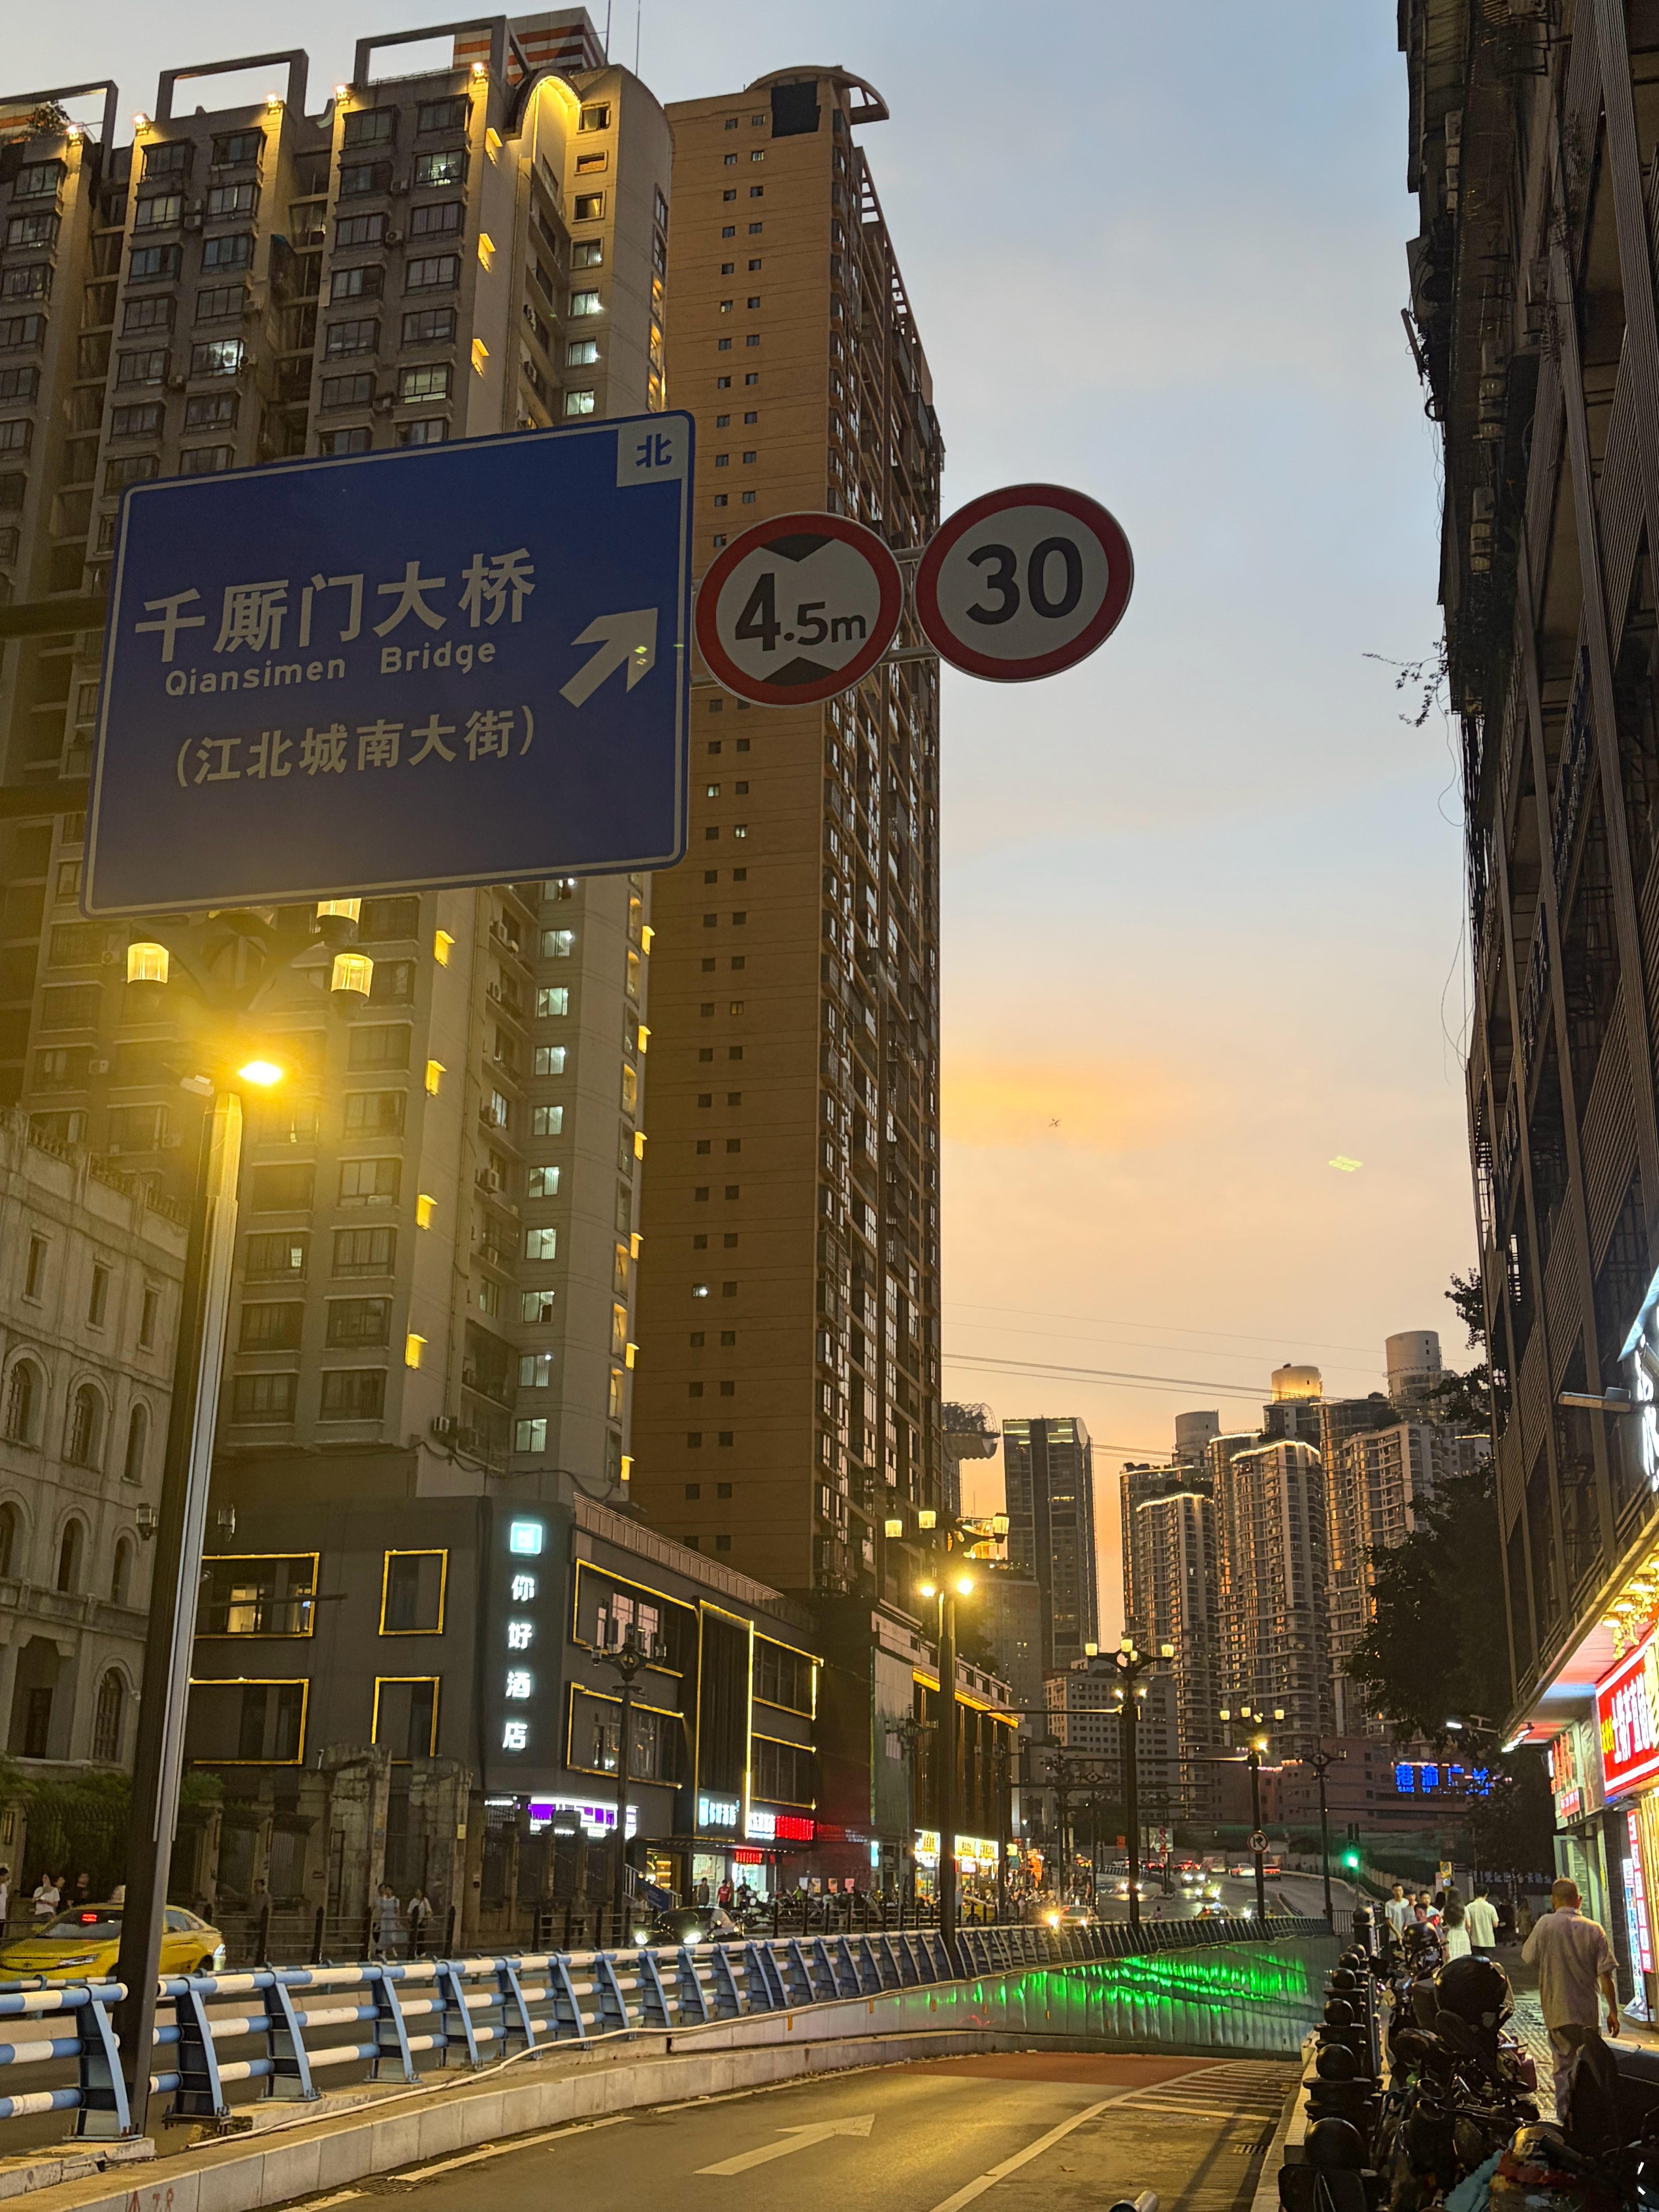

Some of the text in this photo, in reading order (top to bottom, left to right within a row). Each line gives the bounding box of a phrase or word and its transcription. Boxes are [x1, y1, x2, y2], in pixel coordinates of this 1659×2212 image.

[636, 434, 672, 468] 北
[135, 548, 535, 663] 千厮门大桥
[735, 572, 867, 652] 4.5m
[965, 537, 1084, 625] 30
[165, 640, 496, 697] Qiansimen Bridge
[176, 705, 534, 787] (江北城南大街)
[503, 1575, 534, 1750] 你好酒店
